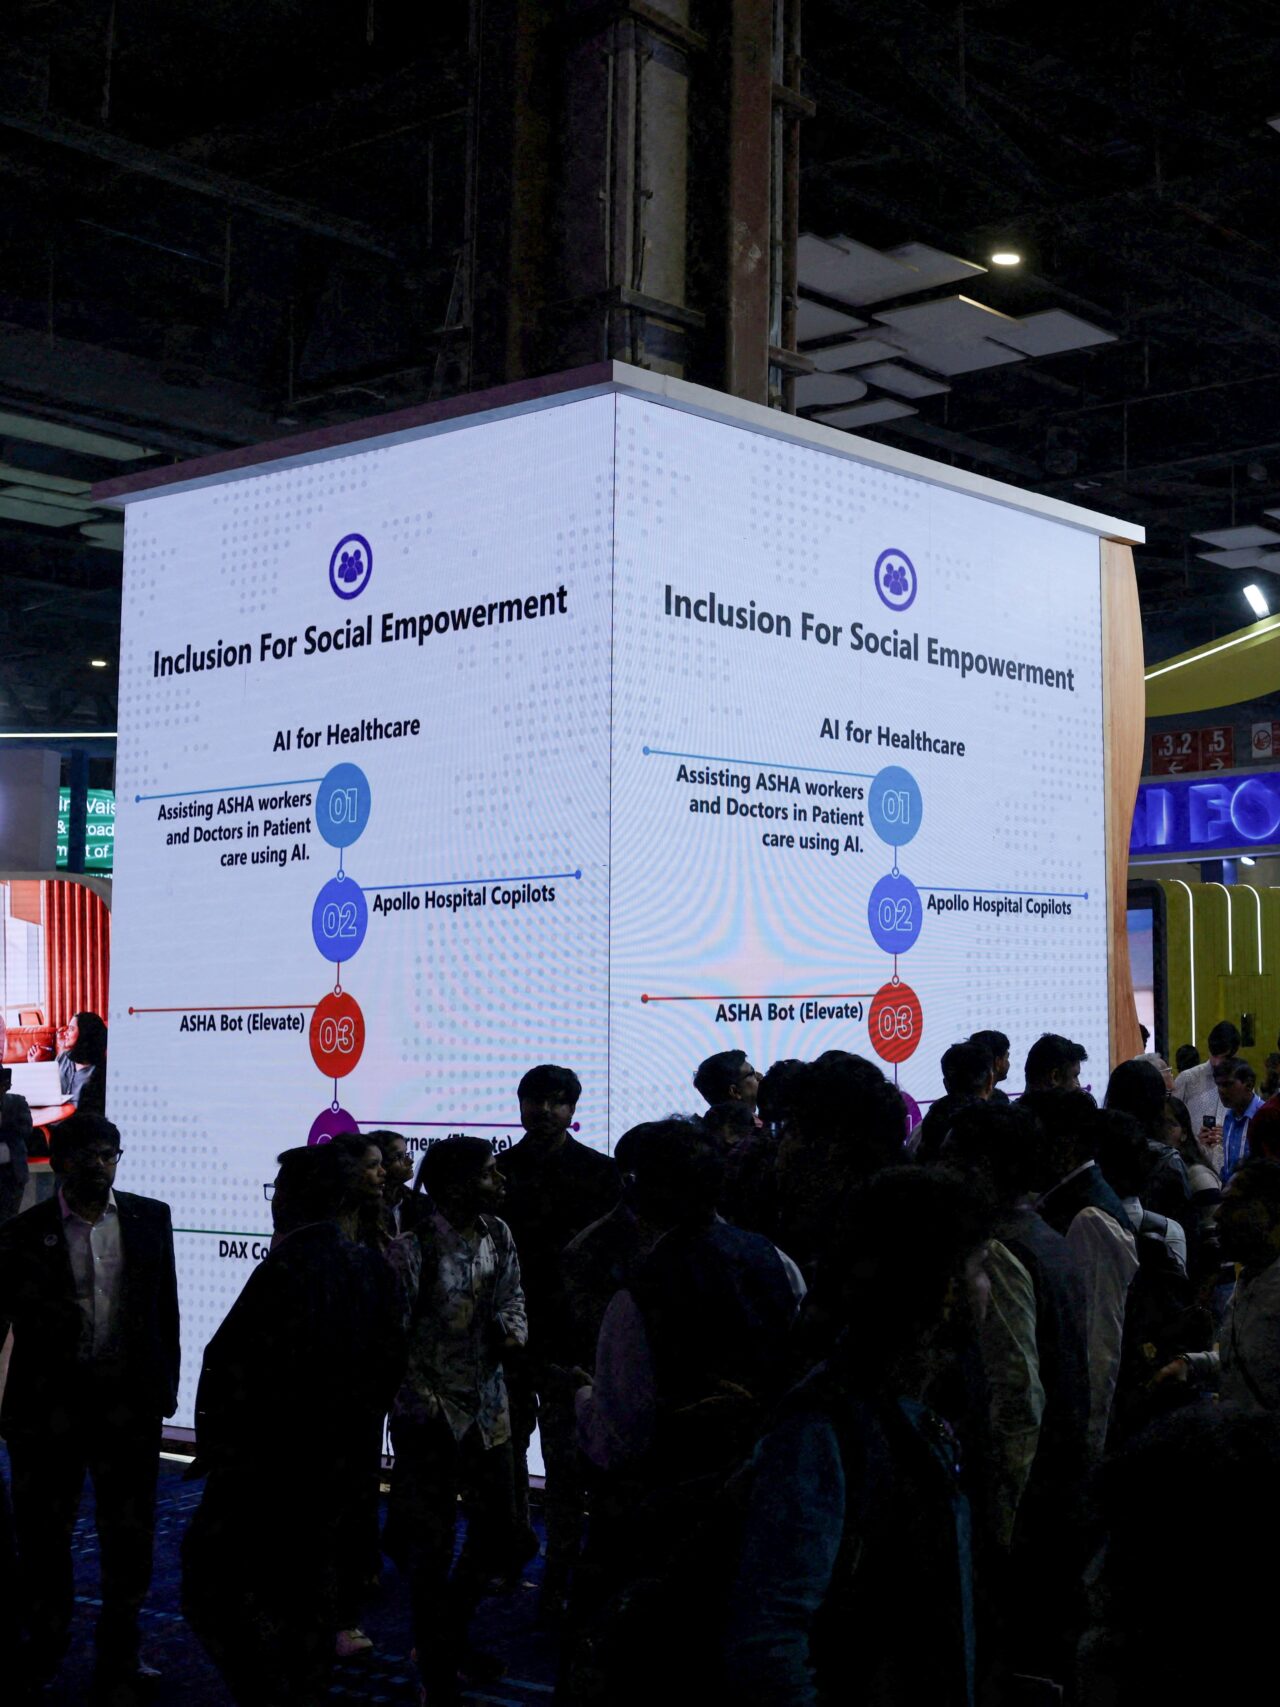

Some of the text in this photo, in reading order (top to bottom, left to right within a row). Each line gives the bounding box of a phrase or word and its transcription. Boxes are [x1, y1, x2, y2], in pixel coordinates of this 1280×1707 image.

[154, 585, 567, 677] Inclusion For Social Empowerment
[665, 584, 1074, 691] Inclusion For Social Empowerment
[273, 718, 420, 751] AI for Healthcare
[820, 718, 965, 756] AI for Healthcare
[676, 764, 863, 800] Assisting ASHA workers
[158, 790, 311, 820] Assisting ASHA workers
[329, 788, 358, 824] 01
[689, 796, 863, 826] and Doctors in Patient
[881, 789, 910, 825] 01
[166, 817, 311, 845] and Doctors in Patient
[762, 832, 863, 856] care using AI.
[94, 845, 109, 858] of
[220, 843, 309, 867] care using AI.
[372, 885, 555, 914] Apollo Hospital Copilots
[879, 897, 913, 932] 02
[927, 894, 1071, 918] Apollo Hospital Copilots
[322, 902, 357, 939] 02
[179, 1012, 304, 1034] ASHA Bot (Elevate)
[715, 1001, 863, 1023] ASHA Bot (Elevate)
[878, 1004, 913, 1040] 03
[319, 1016, 355, 1053] 03
[219, 1240, 247, 1259] DAX
